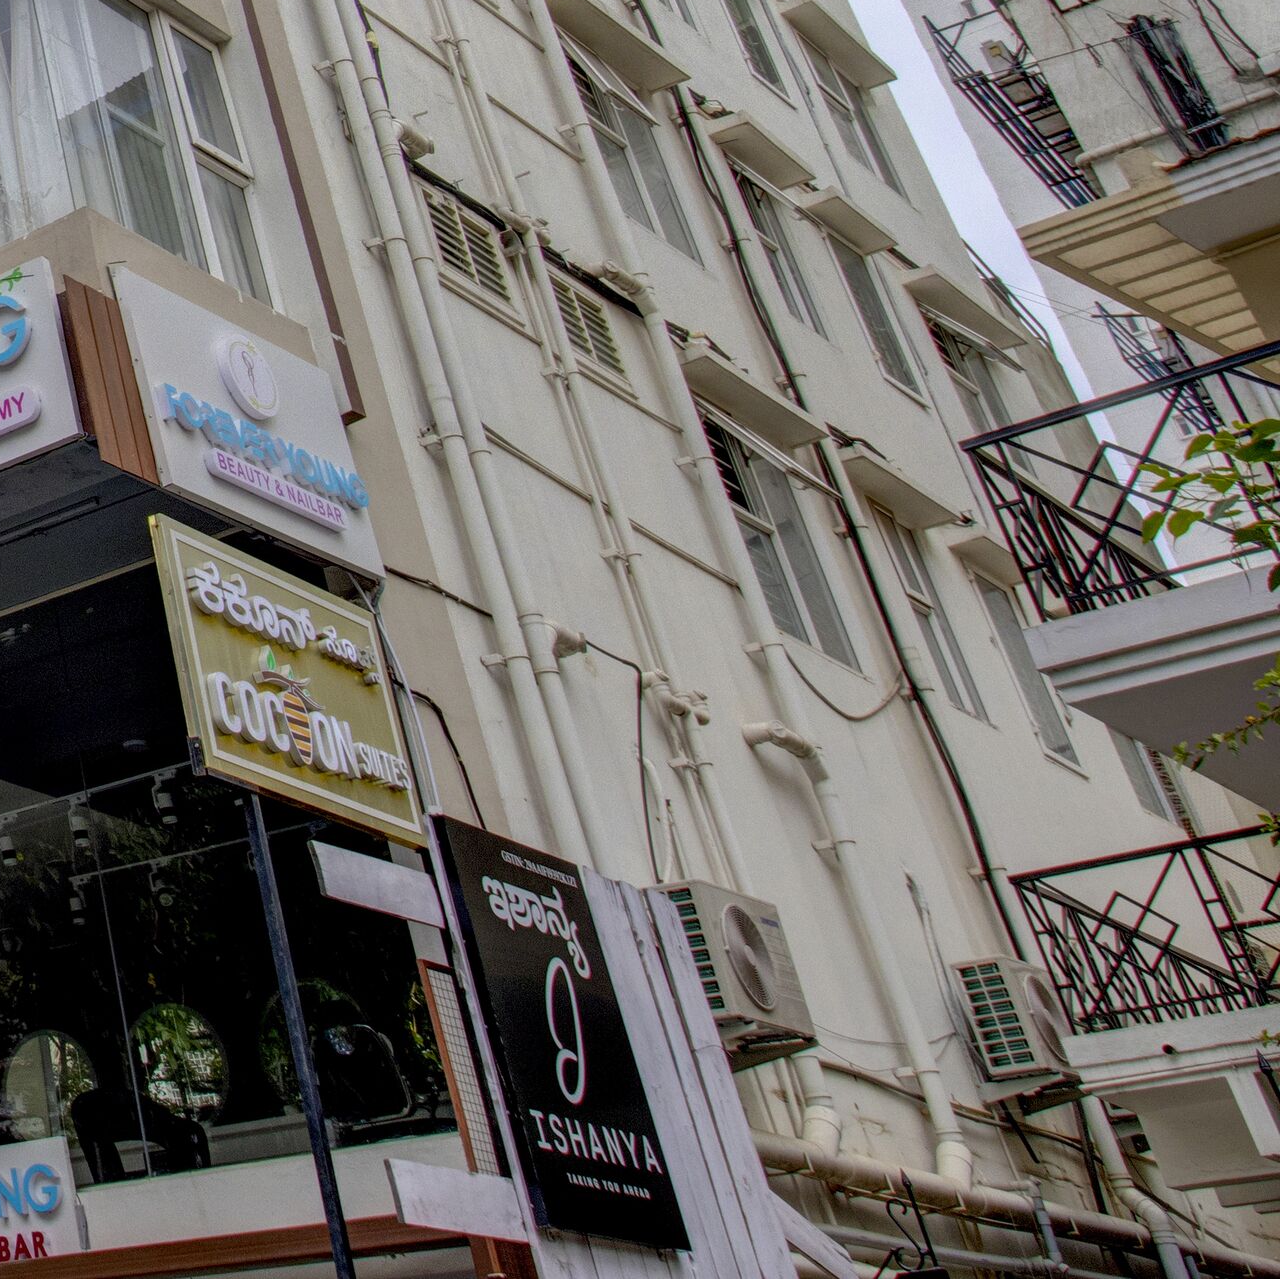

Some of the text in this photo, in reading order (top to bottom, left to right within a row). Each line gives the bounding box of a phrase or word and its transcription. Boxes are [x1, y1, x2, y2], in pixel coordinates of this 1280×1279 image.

[217, 452, 345, 524] BEAUTY & NAILBAR
[277, 437, 369, 507] YOUNG
[358, 742, 412, 790] SUITES
[529, 1109, 663, 1175] ISHANYA
[566, 1172, 651, 1200] TAKING YOU AHEAD
